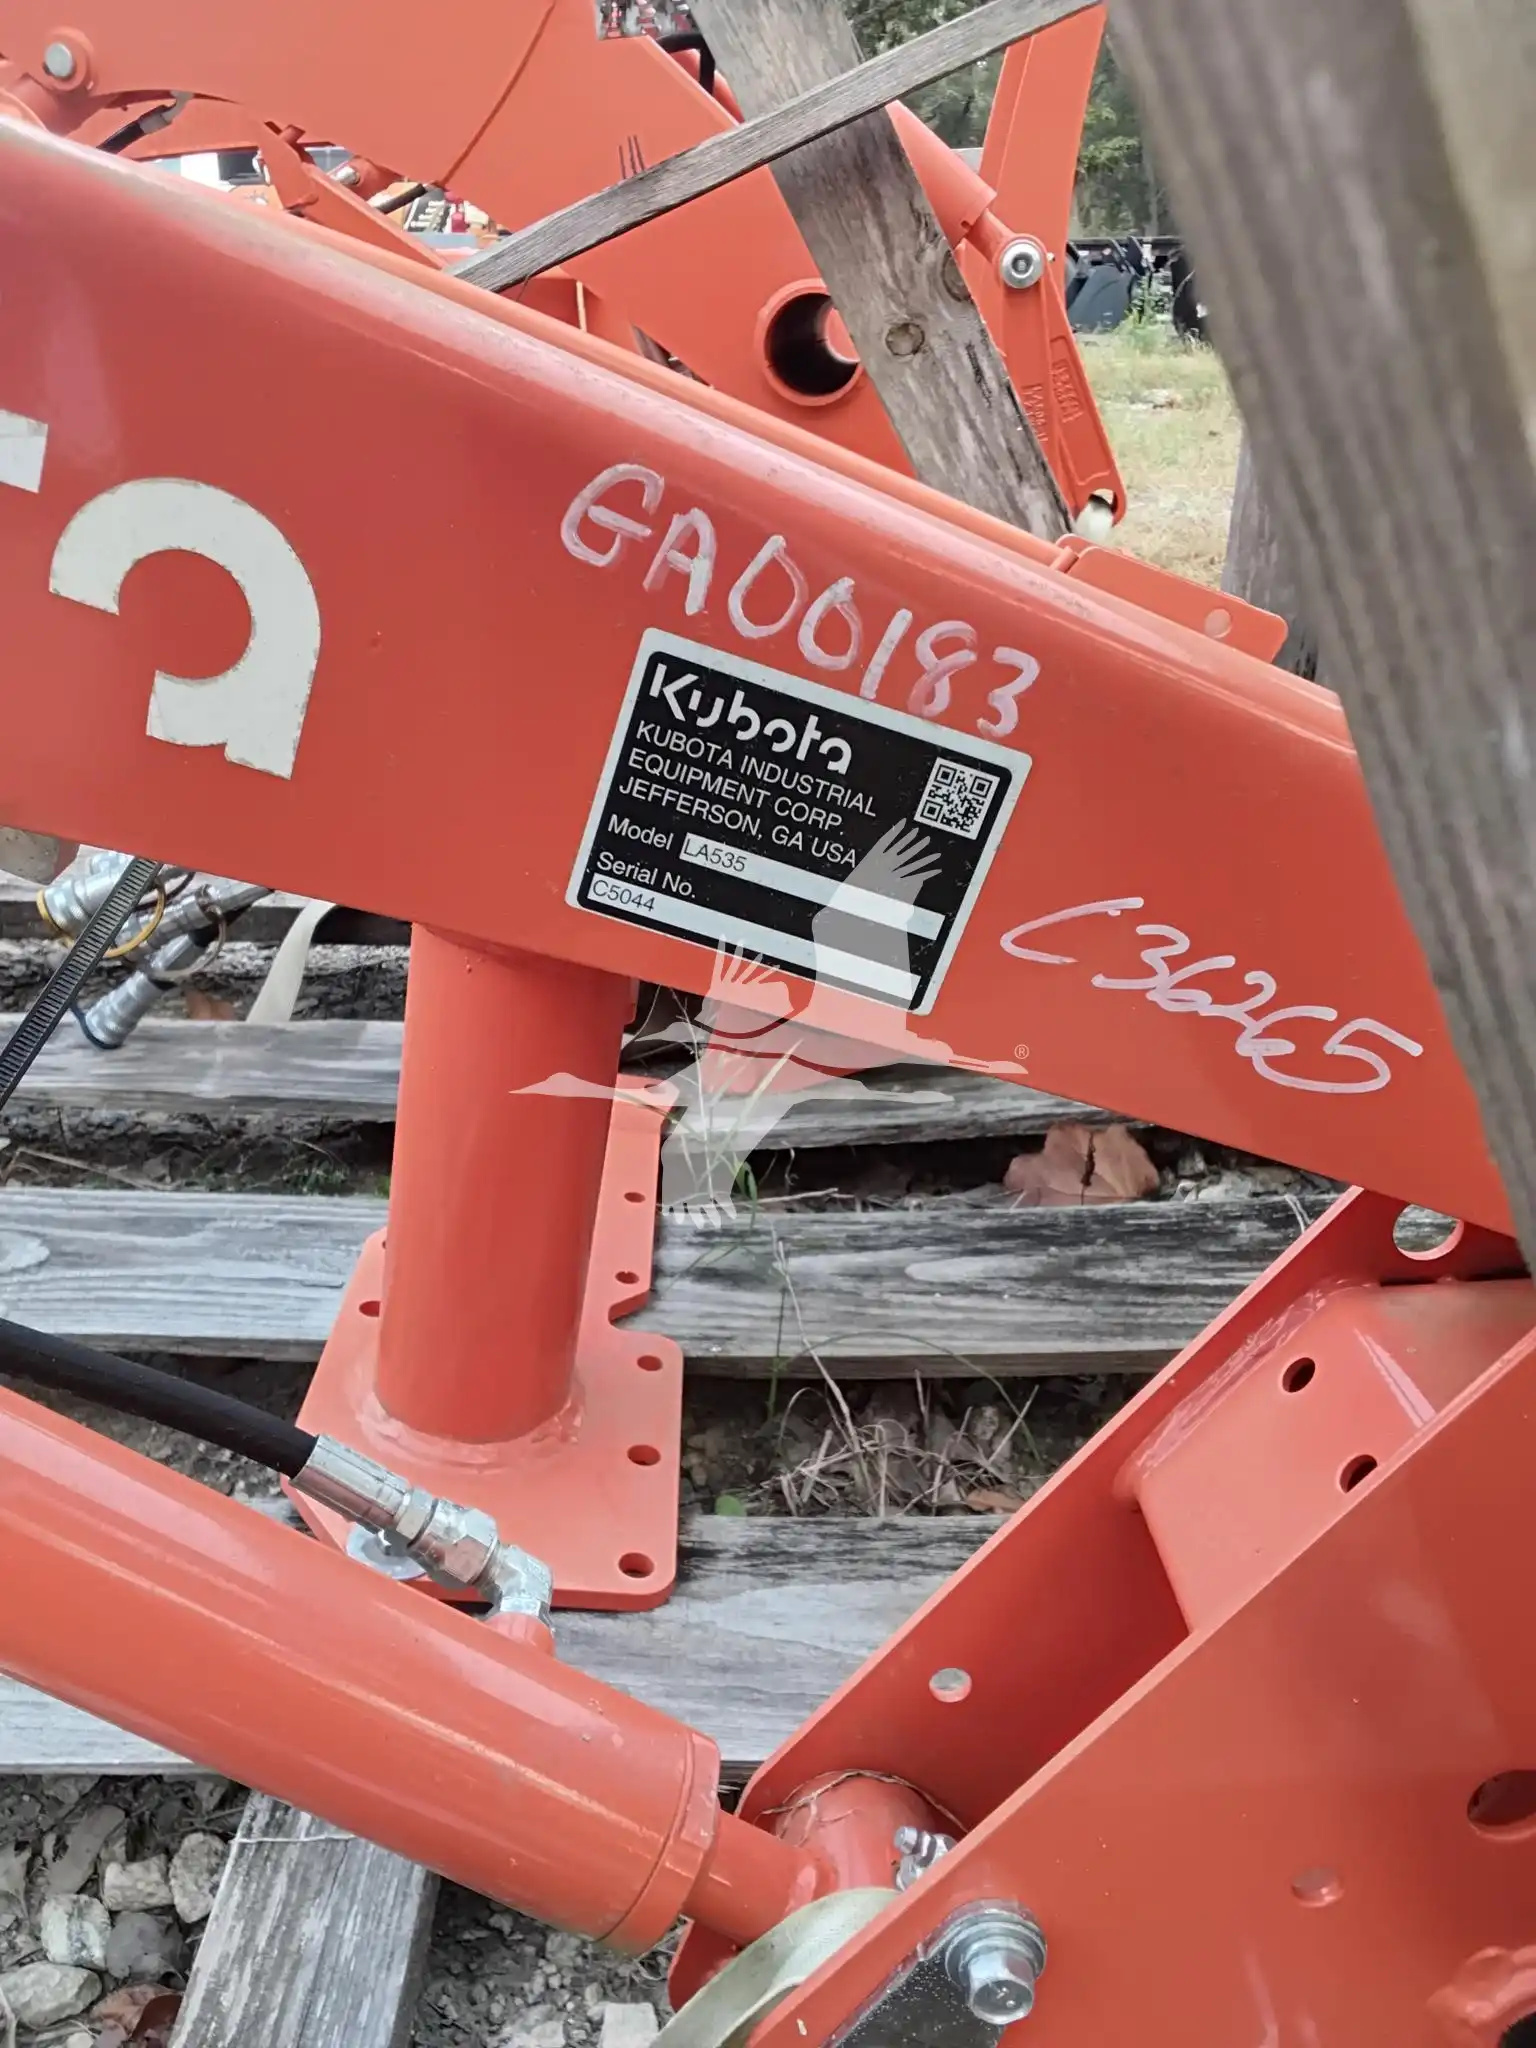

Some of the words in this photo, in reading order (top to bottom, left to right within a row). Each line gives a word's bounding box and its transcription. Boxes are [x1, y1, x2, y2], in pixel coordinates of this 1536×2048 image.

[0, 409, 321, 780] a
[560, 463, 1039, 737] GA00183
[648, 662, 853, 775] Kubota
[627, 747, 771, 808] EQUIPMENT
[774, 796, 845, 837] CORP.
[635, 719, 734, 771] KUBOTA
[740, 755, 877, 817] INDUSTRIAL
[607, 813, 674, 852] Model
[683, 837, 747, 874] LA535
[619, 774, 763, 841] JEFFERSON,
[771, 826, 804, 852] GA
[811, 838, 857, 868] USA
[592, 877, 656, 913] C5044
[597, 850, 657, 887] Serial
[662, 870, 697, 900] No.
